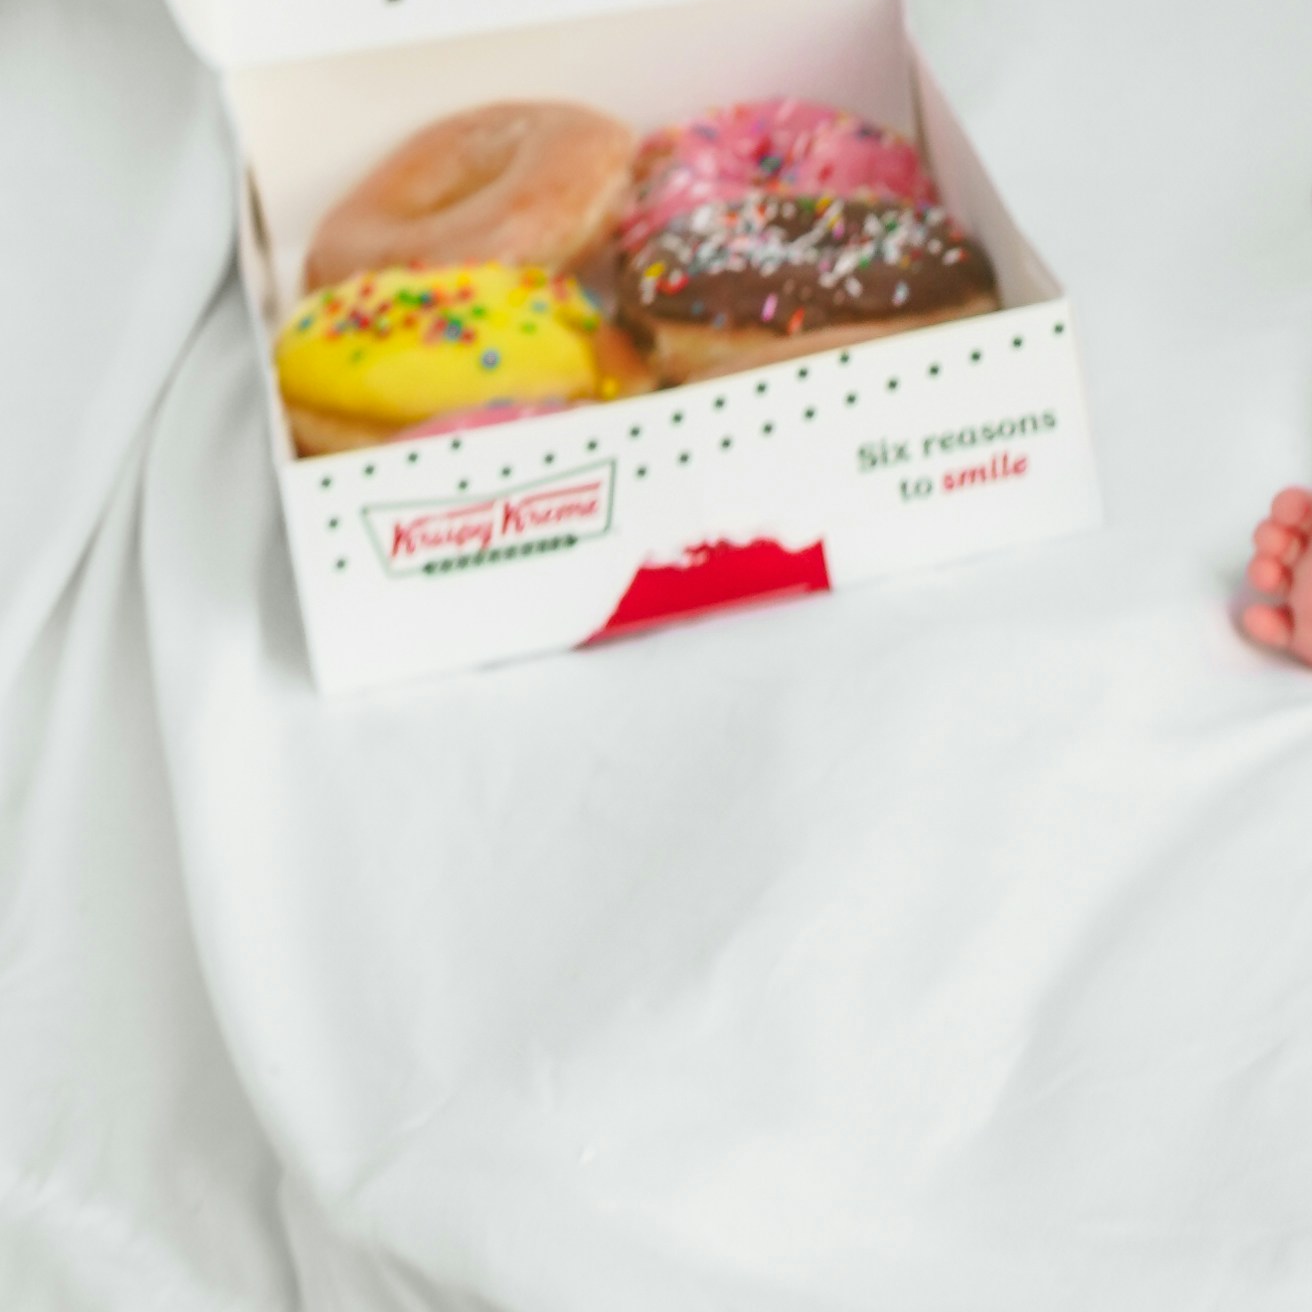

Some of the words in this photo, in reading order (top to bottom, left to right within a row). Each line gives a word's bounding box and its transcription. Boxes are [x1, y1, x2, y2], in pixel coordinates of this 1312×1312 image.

[858, 440, 911, 472] Six
[922, 410, 1056, 457] reasons
[900, 468, 933, 501] to
[943, 450, 1028, 492] smile
